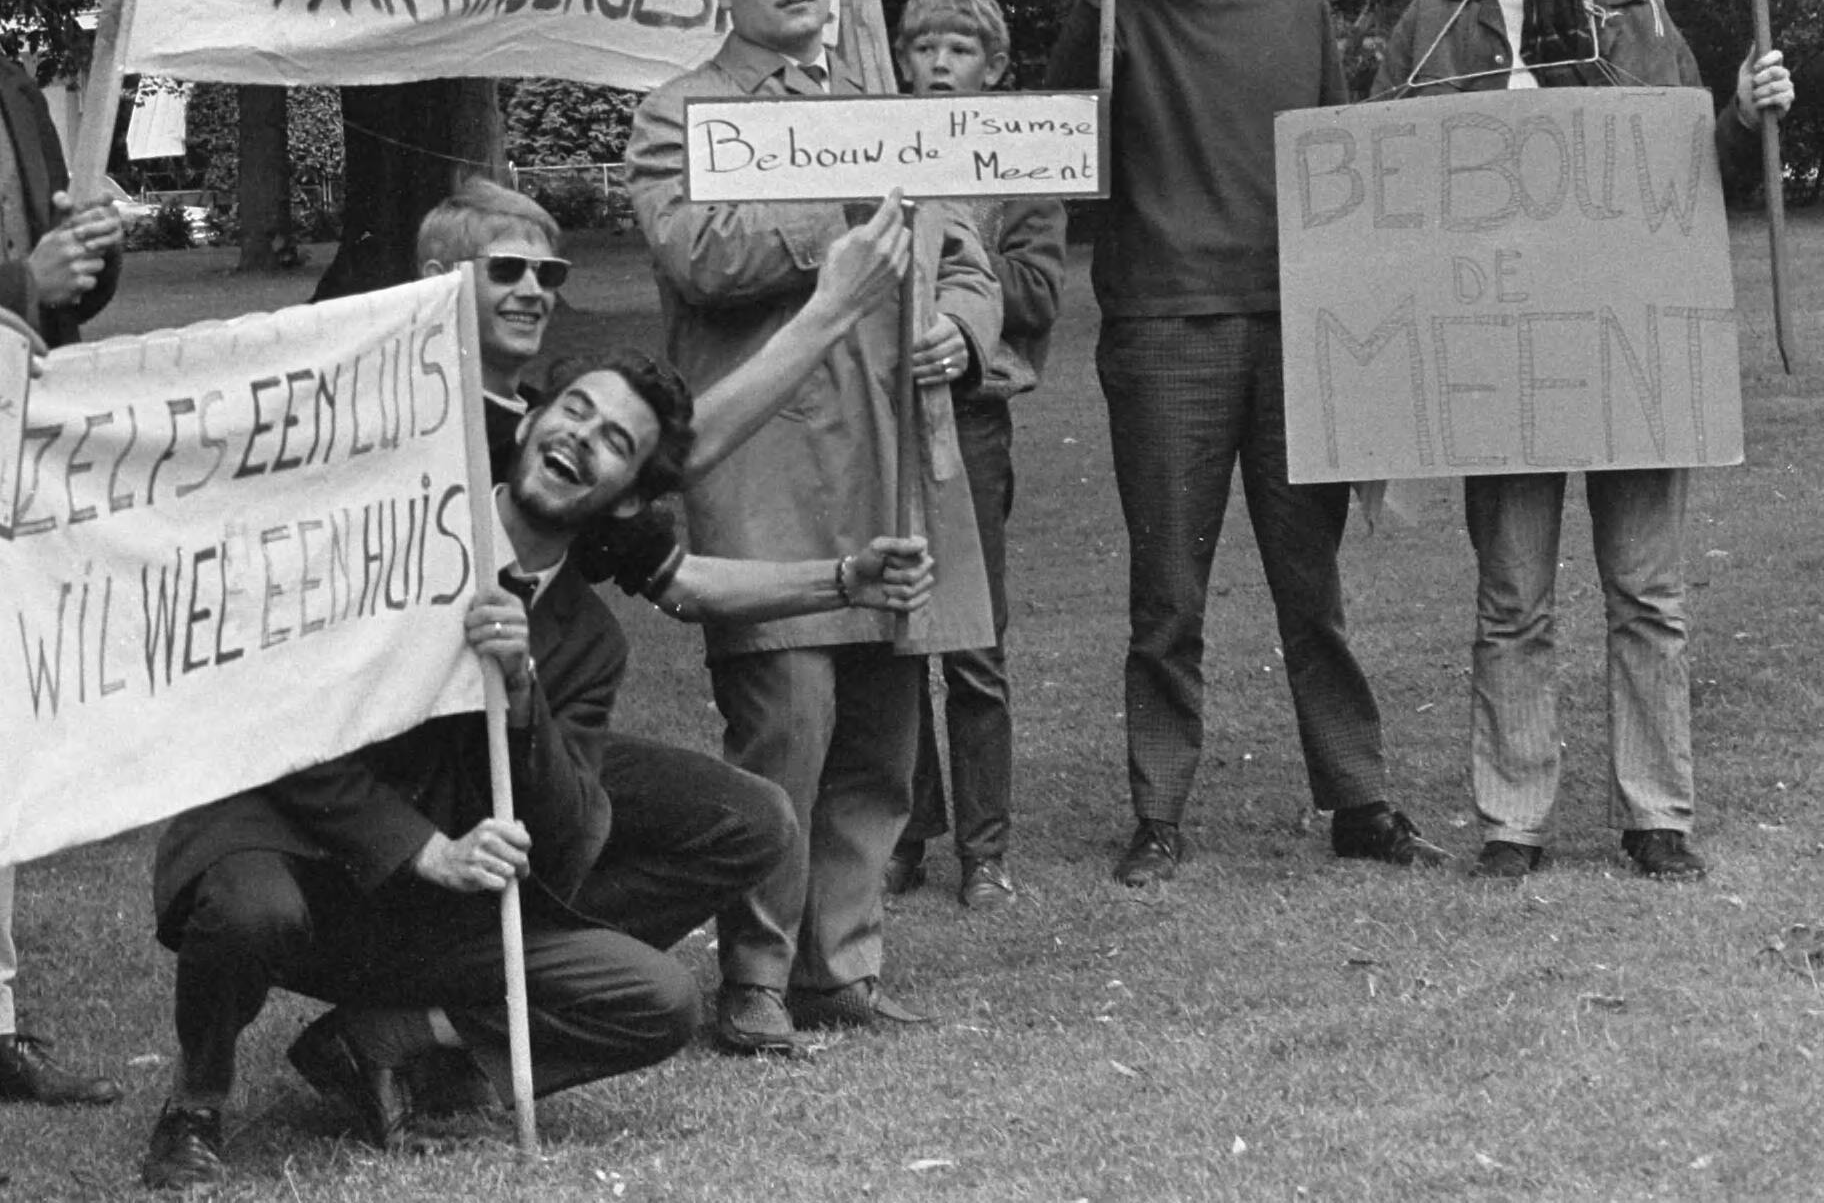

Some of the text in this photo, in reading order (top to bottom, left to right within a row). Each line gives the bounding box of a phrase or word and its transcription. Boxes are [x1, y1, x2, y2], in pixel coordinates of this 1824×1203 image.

[695, 110, 1094, 174] Bebouw de H'sumse
[972, 149, 1094, 182] Meent
[1295, 106, 1706, 238] BEBOUW
[1452, 248, 1529, 295] DE
[1315, 294, 1738, 470] MEENT
[14, 390, 228, 537] ZELFS
[232, 362, 344, 480] EEN
[260, 507, 354, 650] EEN
